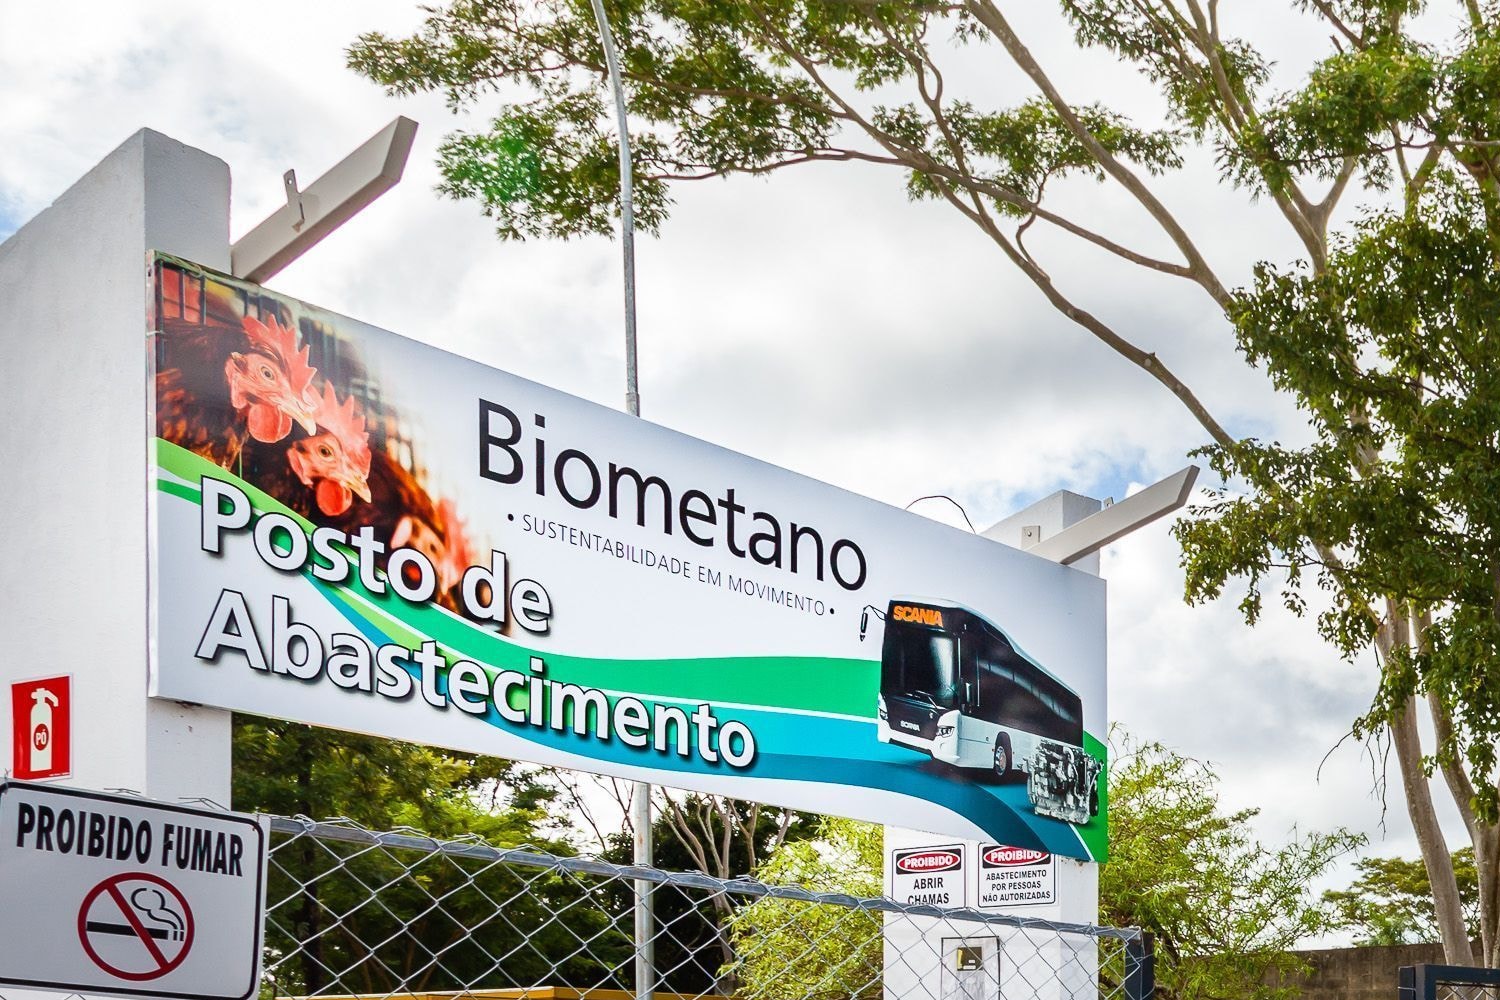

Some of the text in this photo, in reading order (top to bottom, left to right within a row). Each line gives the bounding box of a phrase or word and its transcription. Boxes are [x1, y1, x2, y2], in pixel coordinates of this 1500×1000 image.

[478, 397, 868, 591] Biometano
[200, 474, 552, 633] Posto de
[522, 514, 825, 616] SUSTENTABILIDADE EM MOVIMENTO
[893, 605, 944, 628] SCANIA
[194, 587, 757, 769] Abastecimento
[35, 729, 47, 745] PÓ
[16, 802, 243, 877] PROIBIDO FUMAR
[904, 855, 953, 869] PROIBIDO
[990, 850, 1042, 862] PROIBIDO
[986, 869, 1047, 881] ABASTECIMENTO
[913, 877, 944, 890] ABRIR
[991, 881, 1041, 891] POR PESSOAS
[908, 893, 949, 905] CHAMAS
[982, 890, 1051, 903] NÃO AUTORIZADAS
